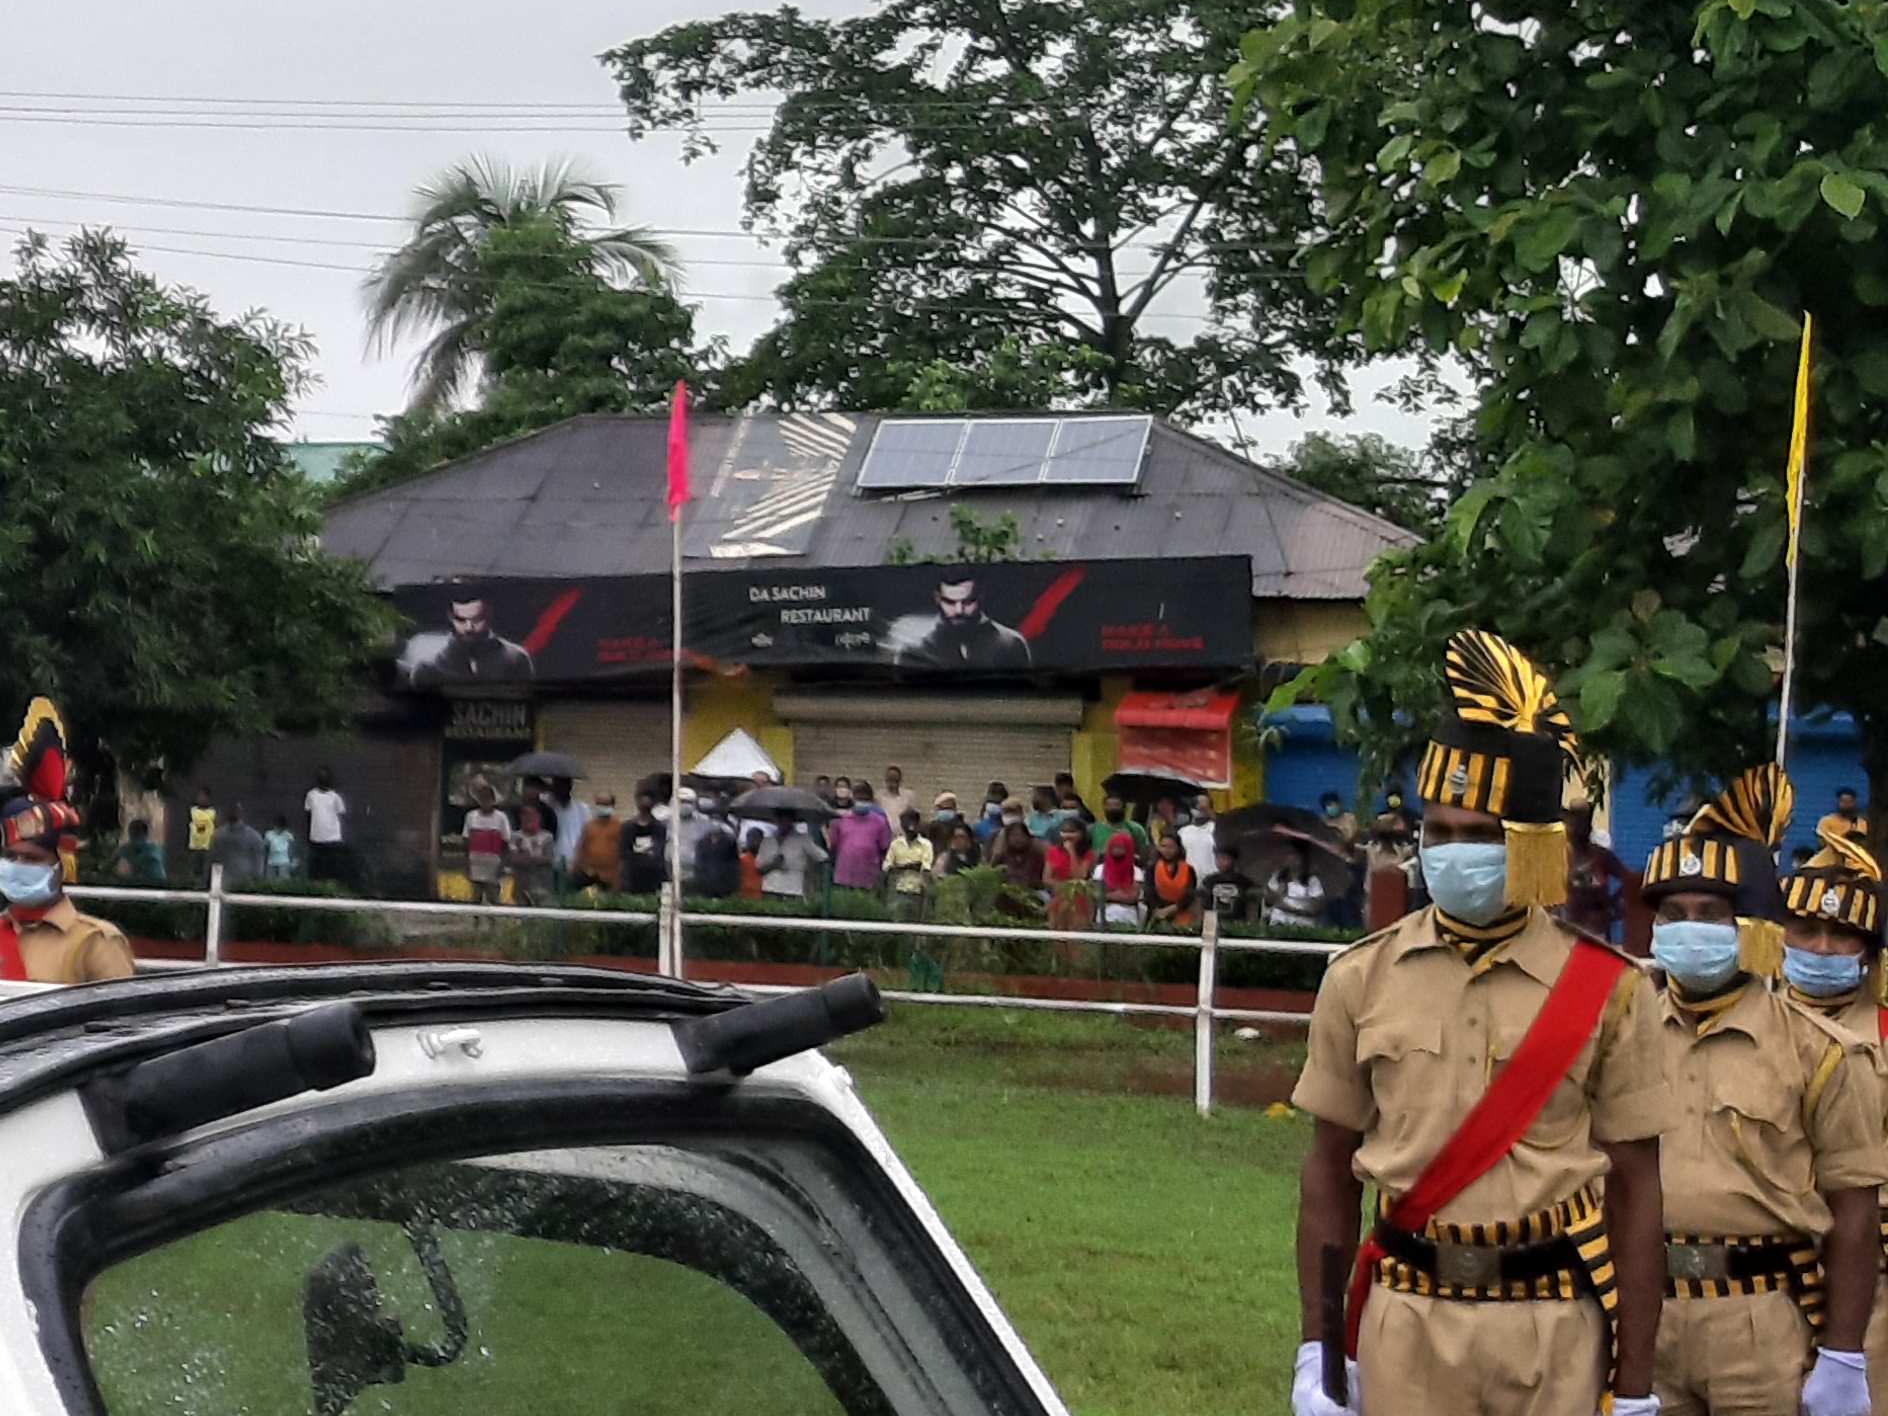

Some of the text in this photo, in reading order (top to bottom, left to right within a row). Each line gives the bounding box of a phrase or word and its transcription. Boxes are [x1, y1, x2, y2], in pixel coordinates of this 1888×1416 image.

[749, 586, 826, 602] DA SACHIN
[780, 607, 871, 624] RESTAURANT
[451, 703, 526, 726] SACHIN
